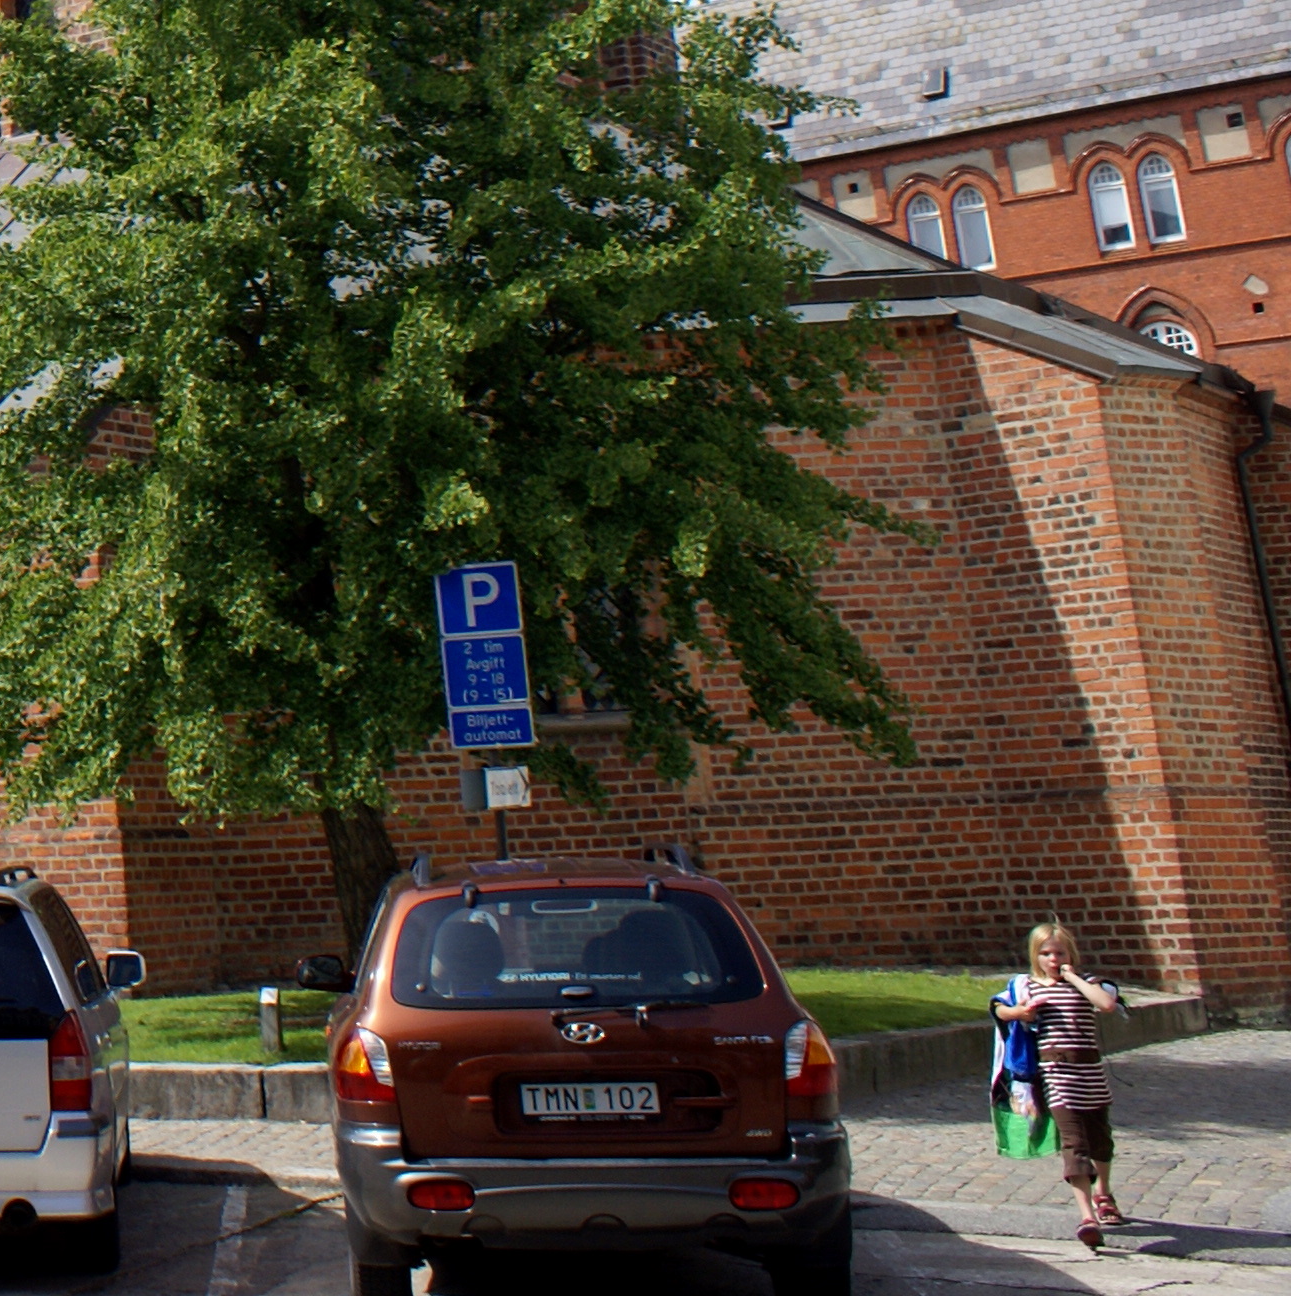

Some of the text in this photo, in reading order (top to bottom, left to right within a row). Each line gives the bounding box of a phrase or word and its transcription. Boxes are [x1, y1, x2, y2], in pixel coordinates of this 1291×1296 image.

[462, 572, 500, 627] P
[463, 641, 504, 654] 2 tim
[466, 657, 506, 672] Avgift
[468, 674, 477, 685] 9
[491, 672, 506, 685] 18
[467, 713, 515, 729] Biljett-
[464, 729, 523, 743] automat
[520, 972, 570, 981] HYUNDAI
[526, 1086, 654, 1111] TMN 102
